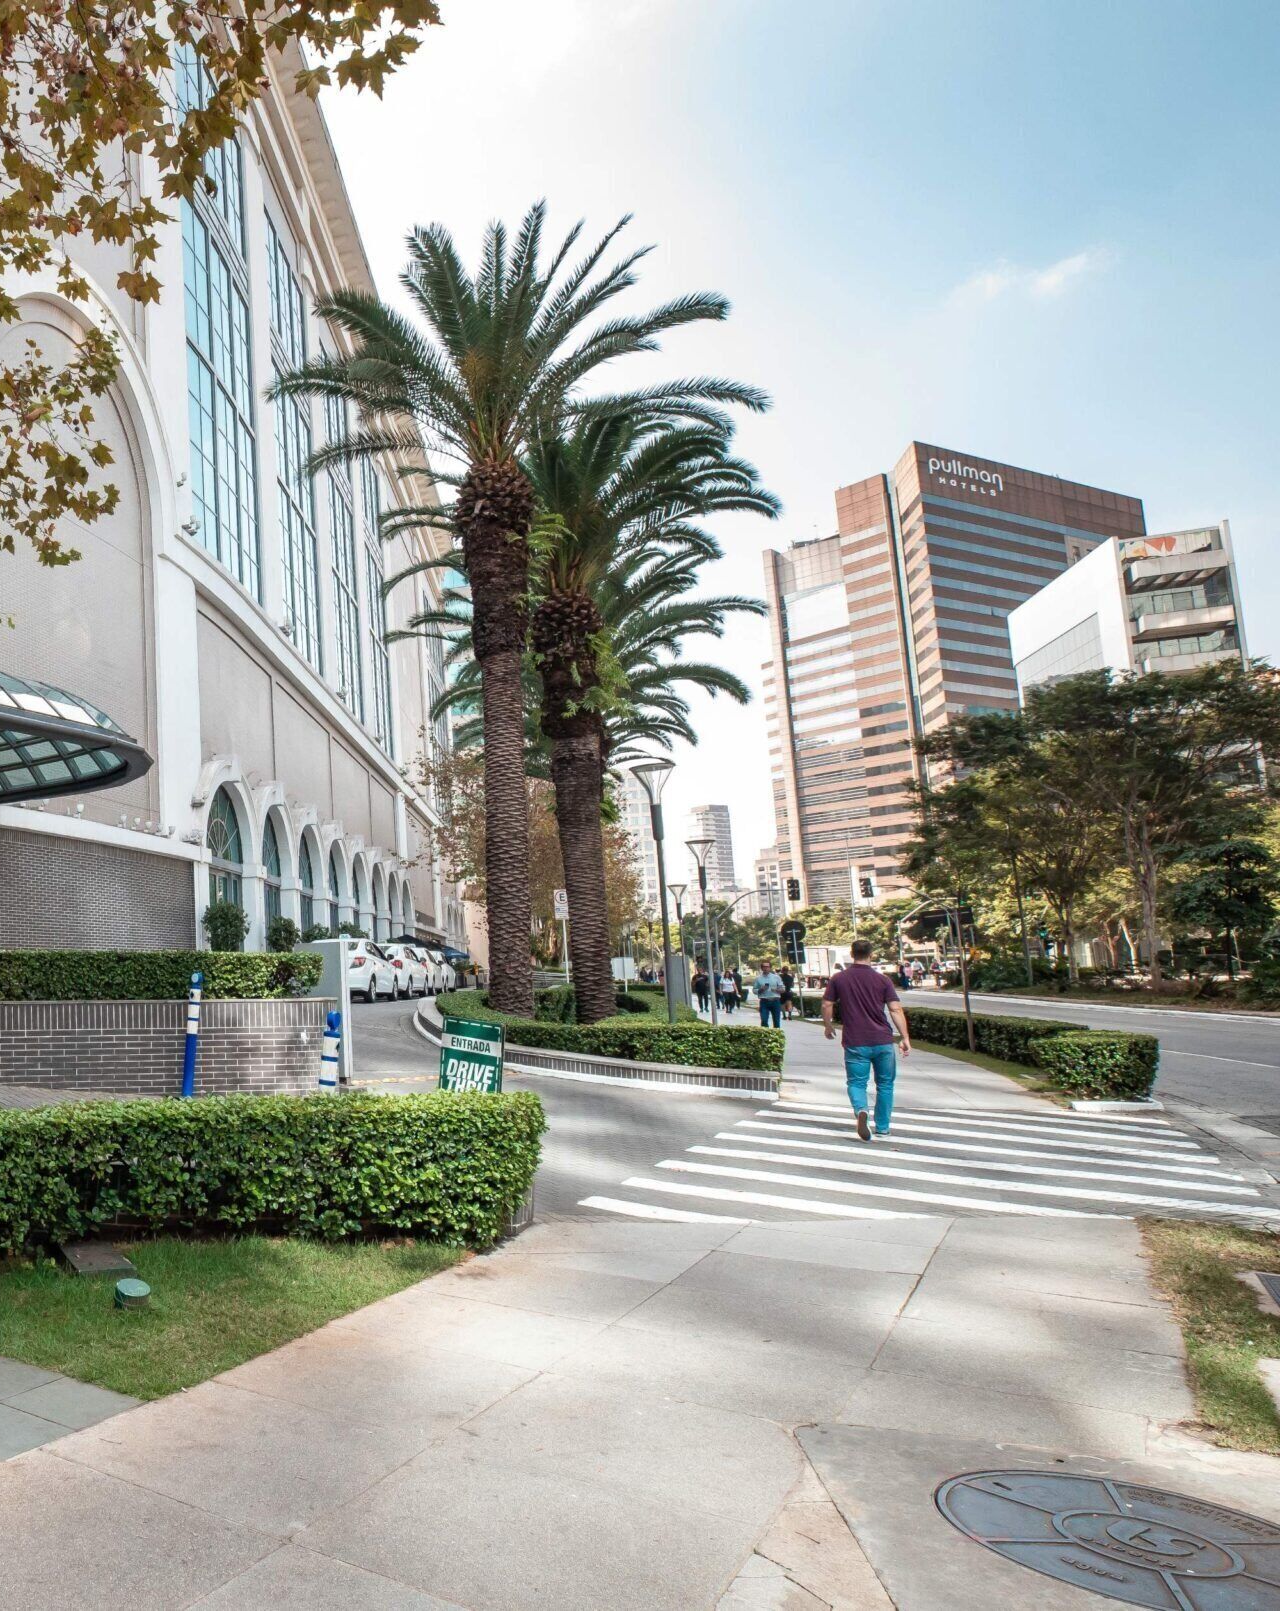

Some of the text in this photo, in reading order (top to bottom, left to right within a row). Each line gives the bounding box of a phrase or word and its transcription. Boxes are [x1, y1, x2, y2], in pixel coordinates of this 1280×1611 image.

[928, 458, 1003, 492] pullman
[938, 477, 997, 497] HOTELS
[451, 1036, 491, 1053] ENTRADA
[446, 1058, 495, 1085] DRIVE
